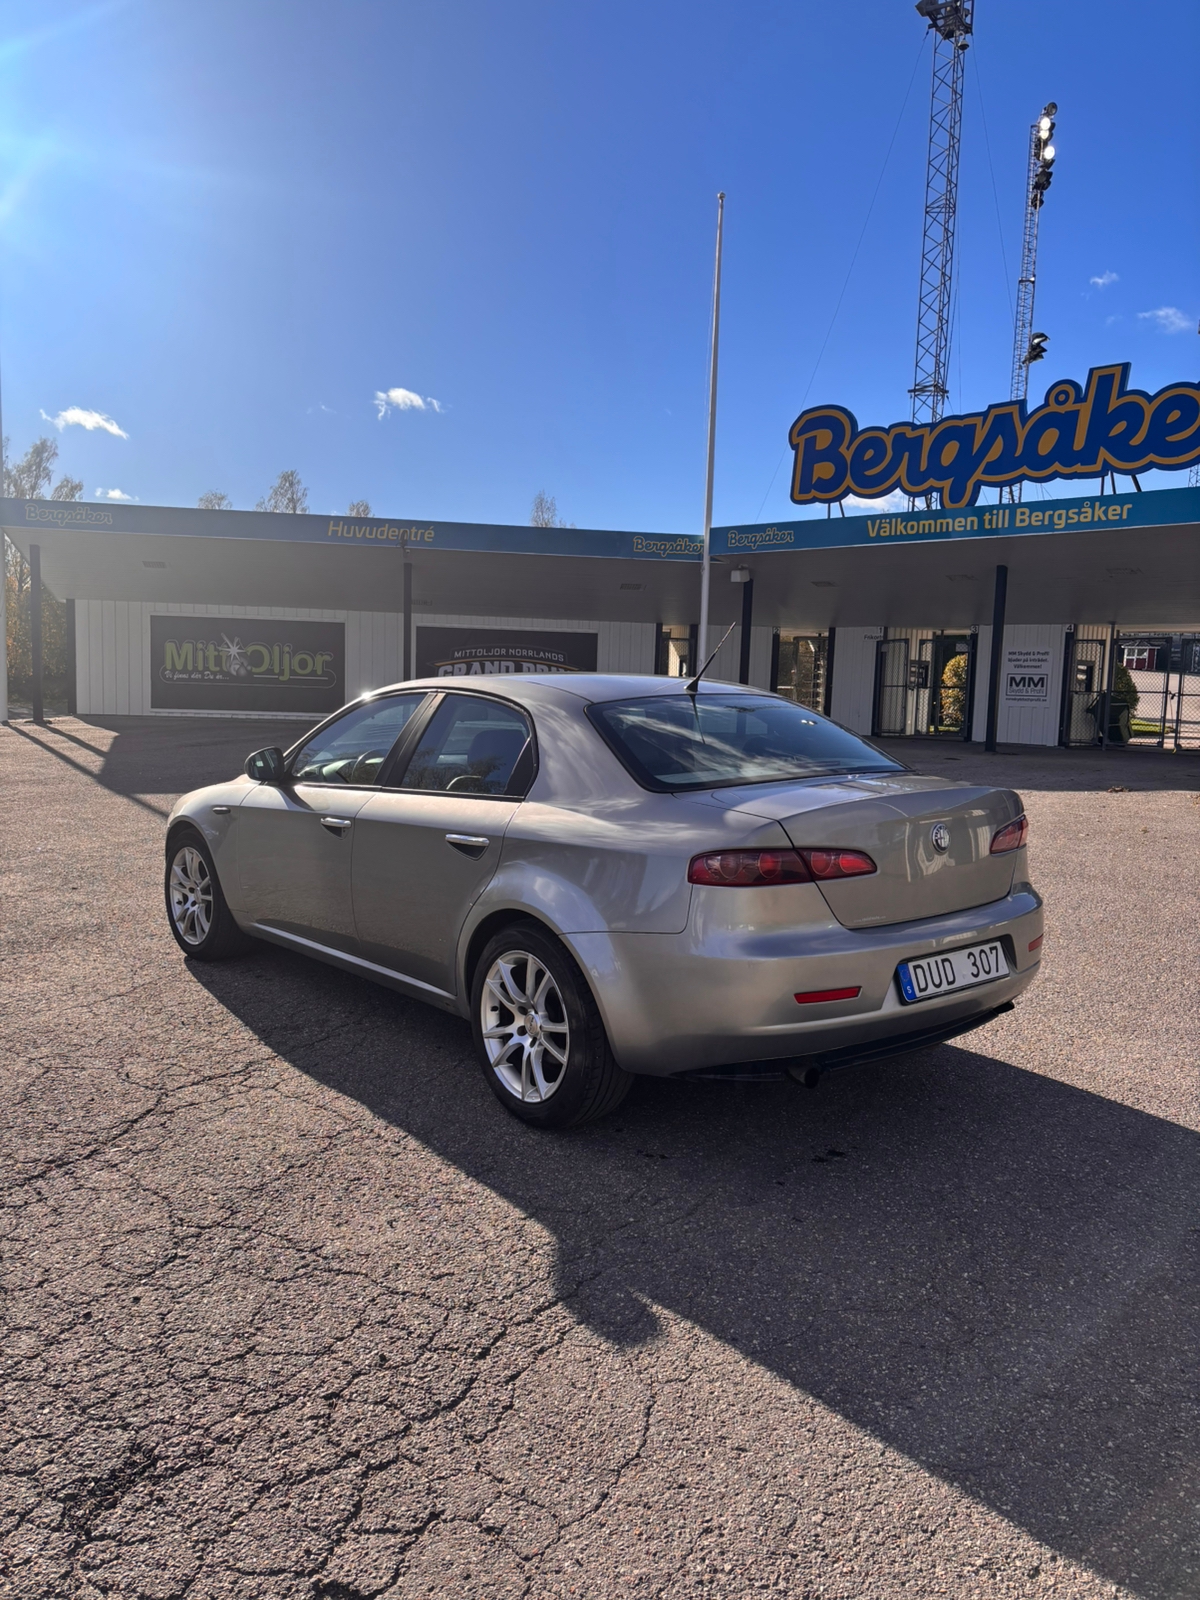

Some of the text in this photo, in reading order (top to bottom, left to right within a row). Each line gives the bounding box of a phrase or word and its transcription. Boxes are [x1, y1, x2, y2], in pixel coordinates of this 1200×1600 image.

[790, 362, 1200, 508] Bergsåke
[25, 503, 113, 526] Bergsåker
[867, 501, 1133, 538] Välkommen till Bergsåker
[327, 520, 435, 542] Huvudentré
[727, 527, 794, 549] Bergsåker
[454, 648, 564, 662] MITTOLJOR NORRLANDS
[1009, 676, 1045, 688] MM
[912, 946, 999, 993] DUD 307
[906, 986, 912, 994] S
